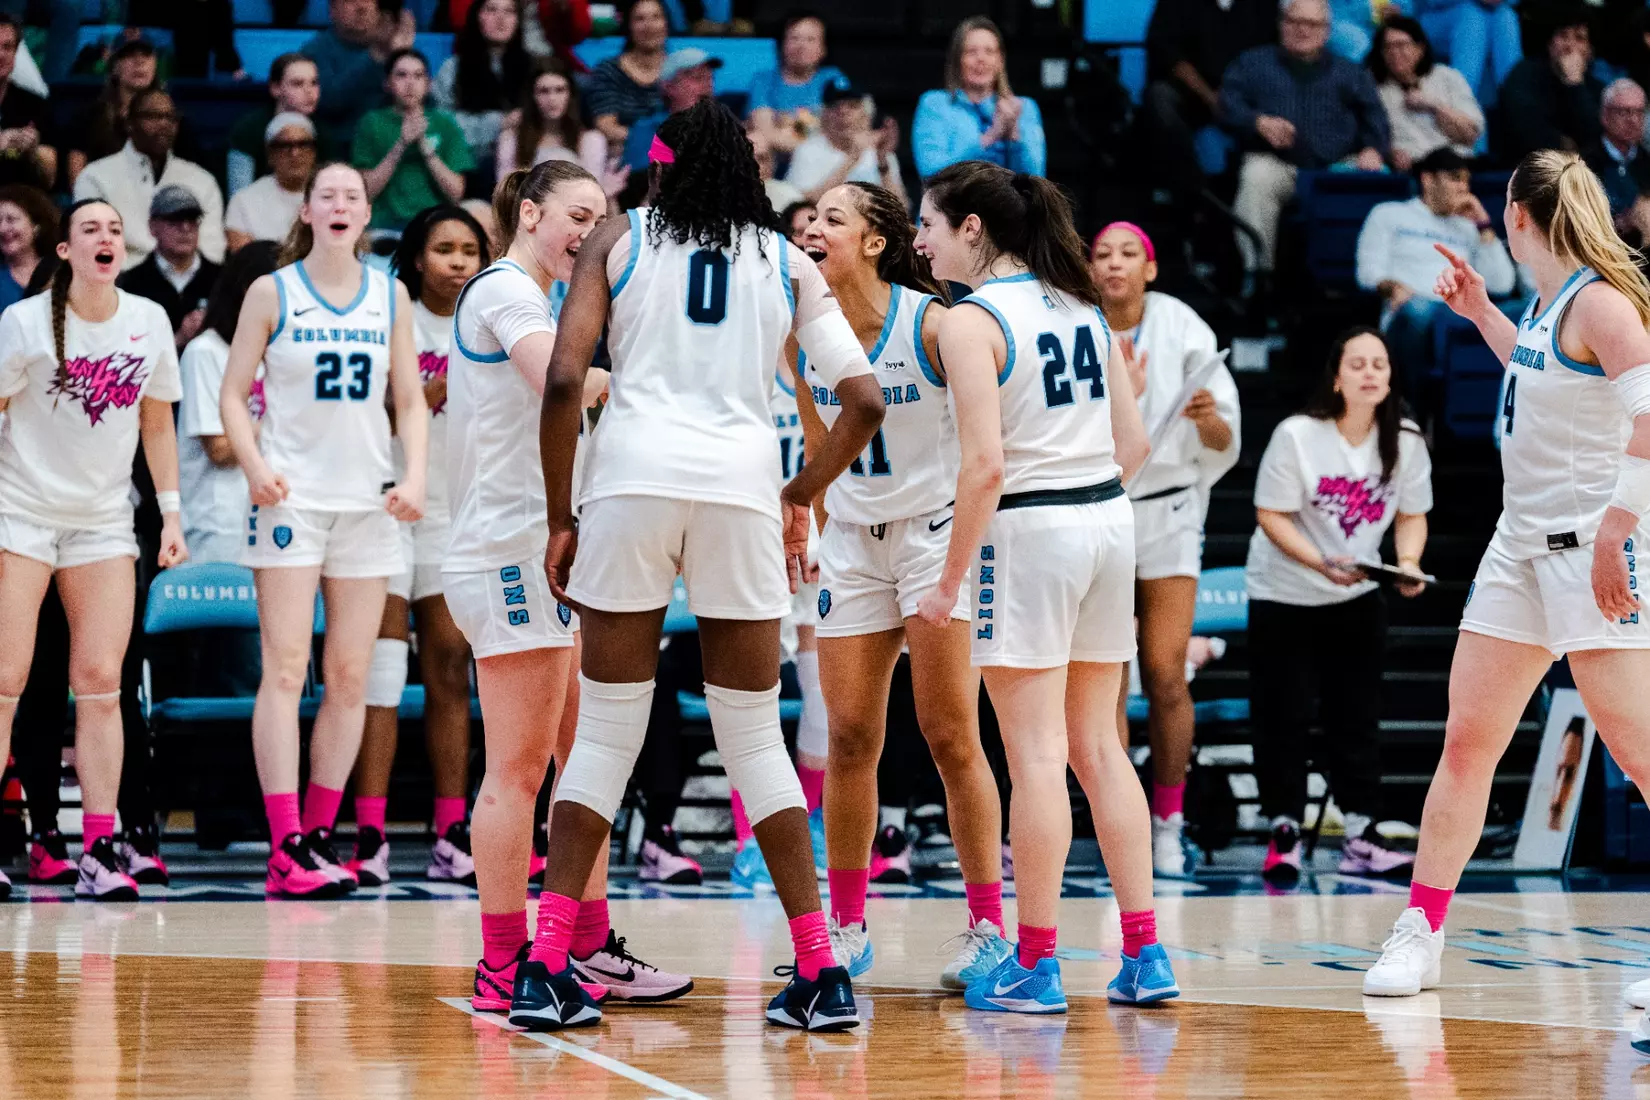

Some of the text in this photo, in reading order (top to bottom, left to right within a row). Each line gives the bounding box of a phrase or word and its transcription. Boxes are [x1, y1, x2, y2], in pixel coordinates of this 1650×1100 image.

[685, 248, 731, 327] 0
[314, 351, 372, 401] 23
[811, 383, 921, 406] COLBIA
[1036, 324, 1106, 410] 24
[1502, 372, 1518, 437] 4
[500, 565, 530, 626] ONS
[977, 545, 995, 639] LIONS
